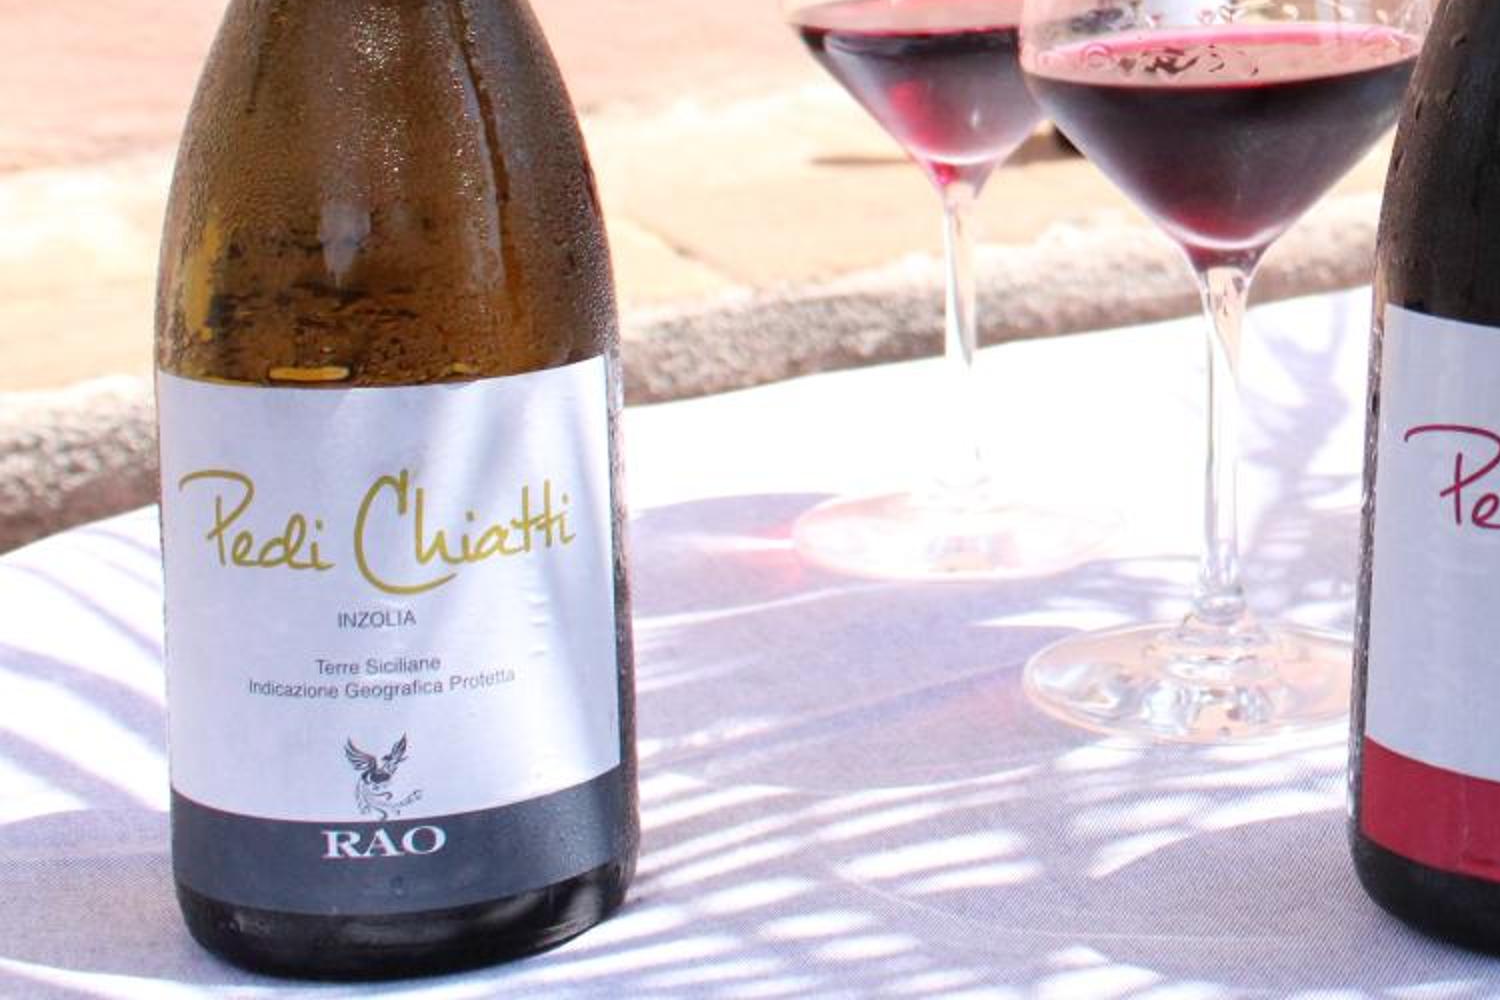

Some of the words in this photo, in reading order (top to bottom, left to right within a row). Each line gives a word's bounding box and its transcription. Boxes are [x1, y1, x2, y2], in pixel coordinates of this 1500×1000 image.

[178, 469, 336, 571] Pedi
[353, 468, 577, 595] Chiatti
[337, 609, 417, 629] INZOLIA
[315, 658, 360, 675] Terre
[365, 654, 441, 675] Siciliane
[248, 679, 339, 699] Indicazione
[345, 679, 444, 702] Geografica
[450, 667, 516, 692] Protetta
[321, 825, 447, 859] RAO
